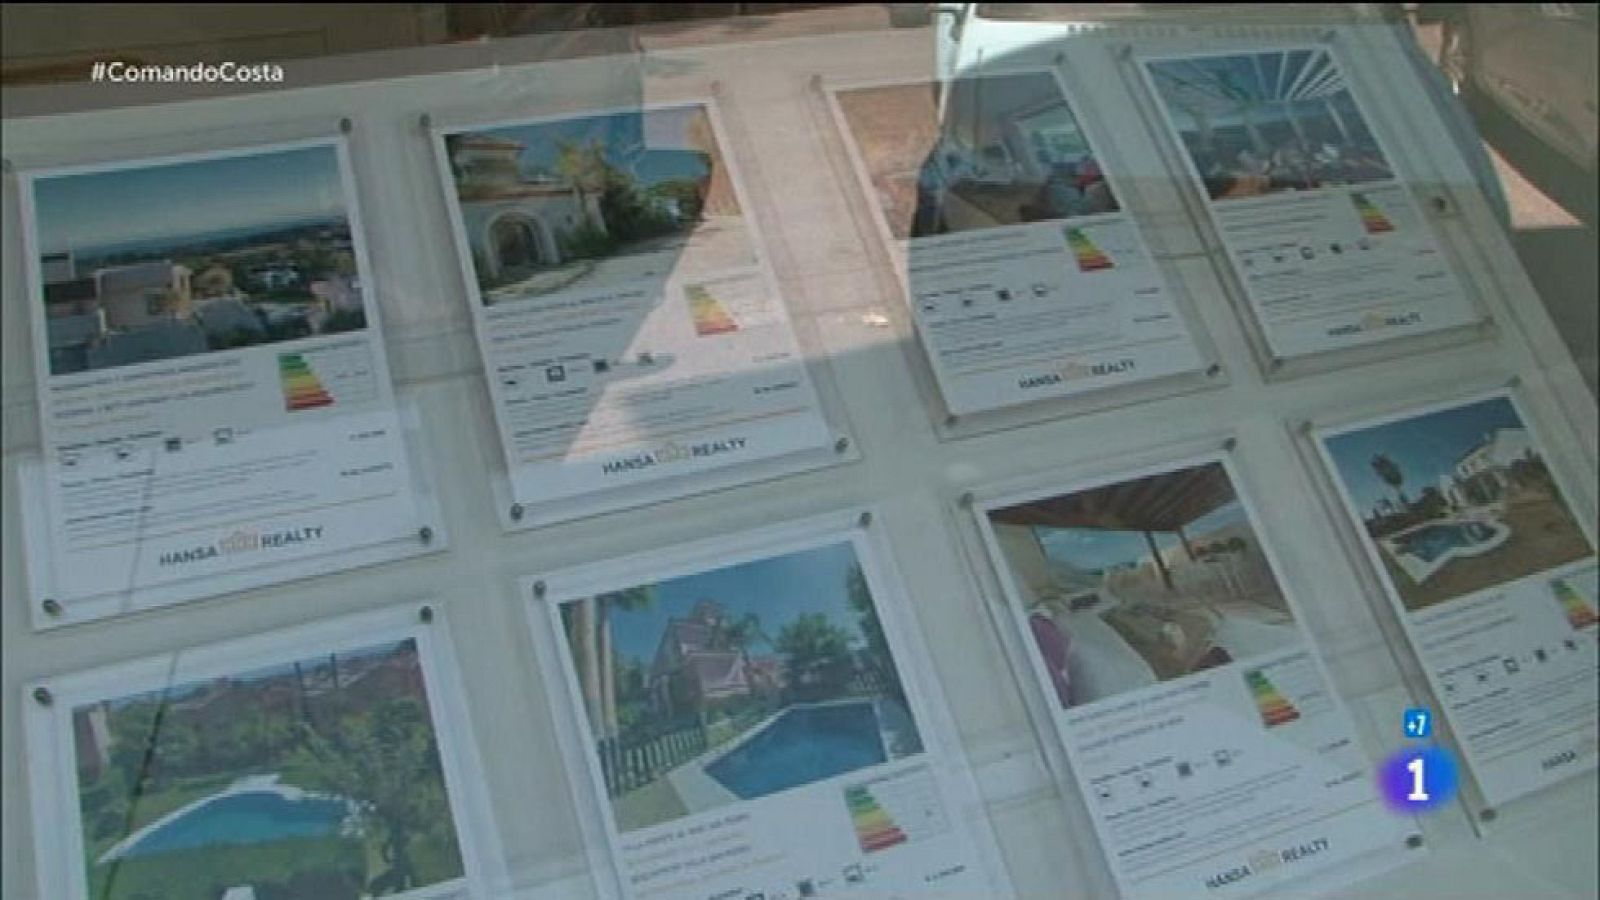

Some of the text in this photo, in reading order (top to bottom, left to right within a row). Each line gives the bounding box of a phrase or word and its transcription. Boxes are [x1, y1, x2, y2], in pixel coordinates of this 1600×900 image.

[1019, 359, 1136, 389] HANSA REALTY
[602, 437, 747, 477] HANSA REALTY
[159, 525, 324, 567] HANSA REALTY
[1205, 837, 1330, 890] HANSA REALTY
